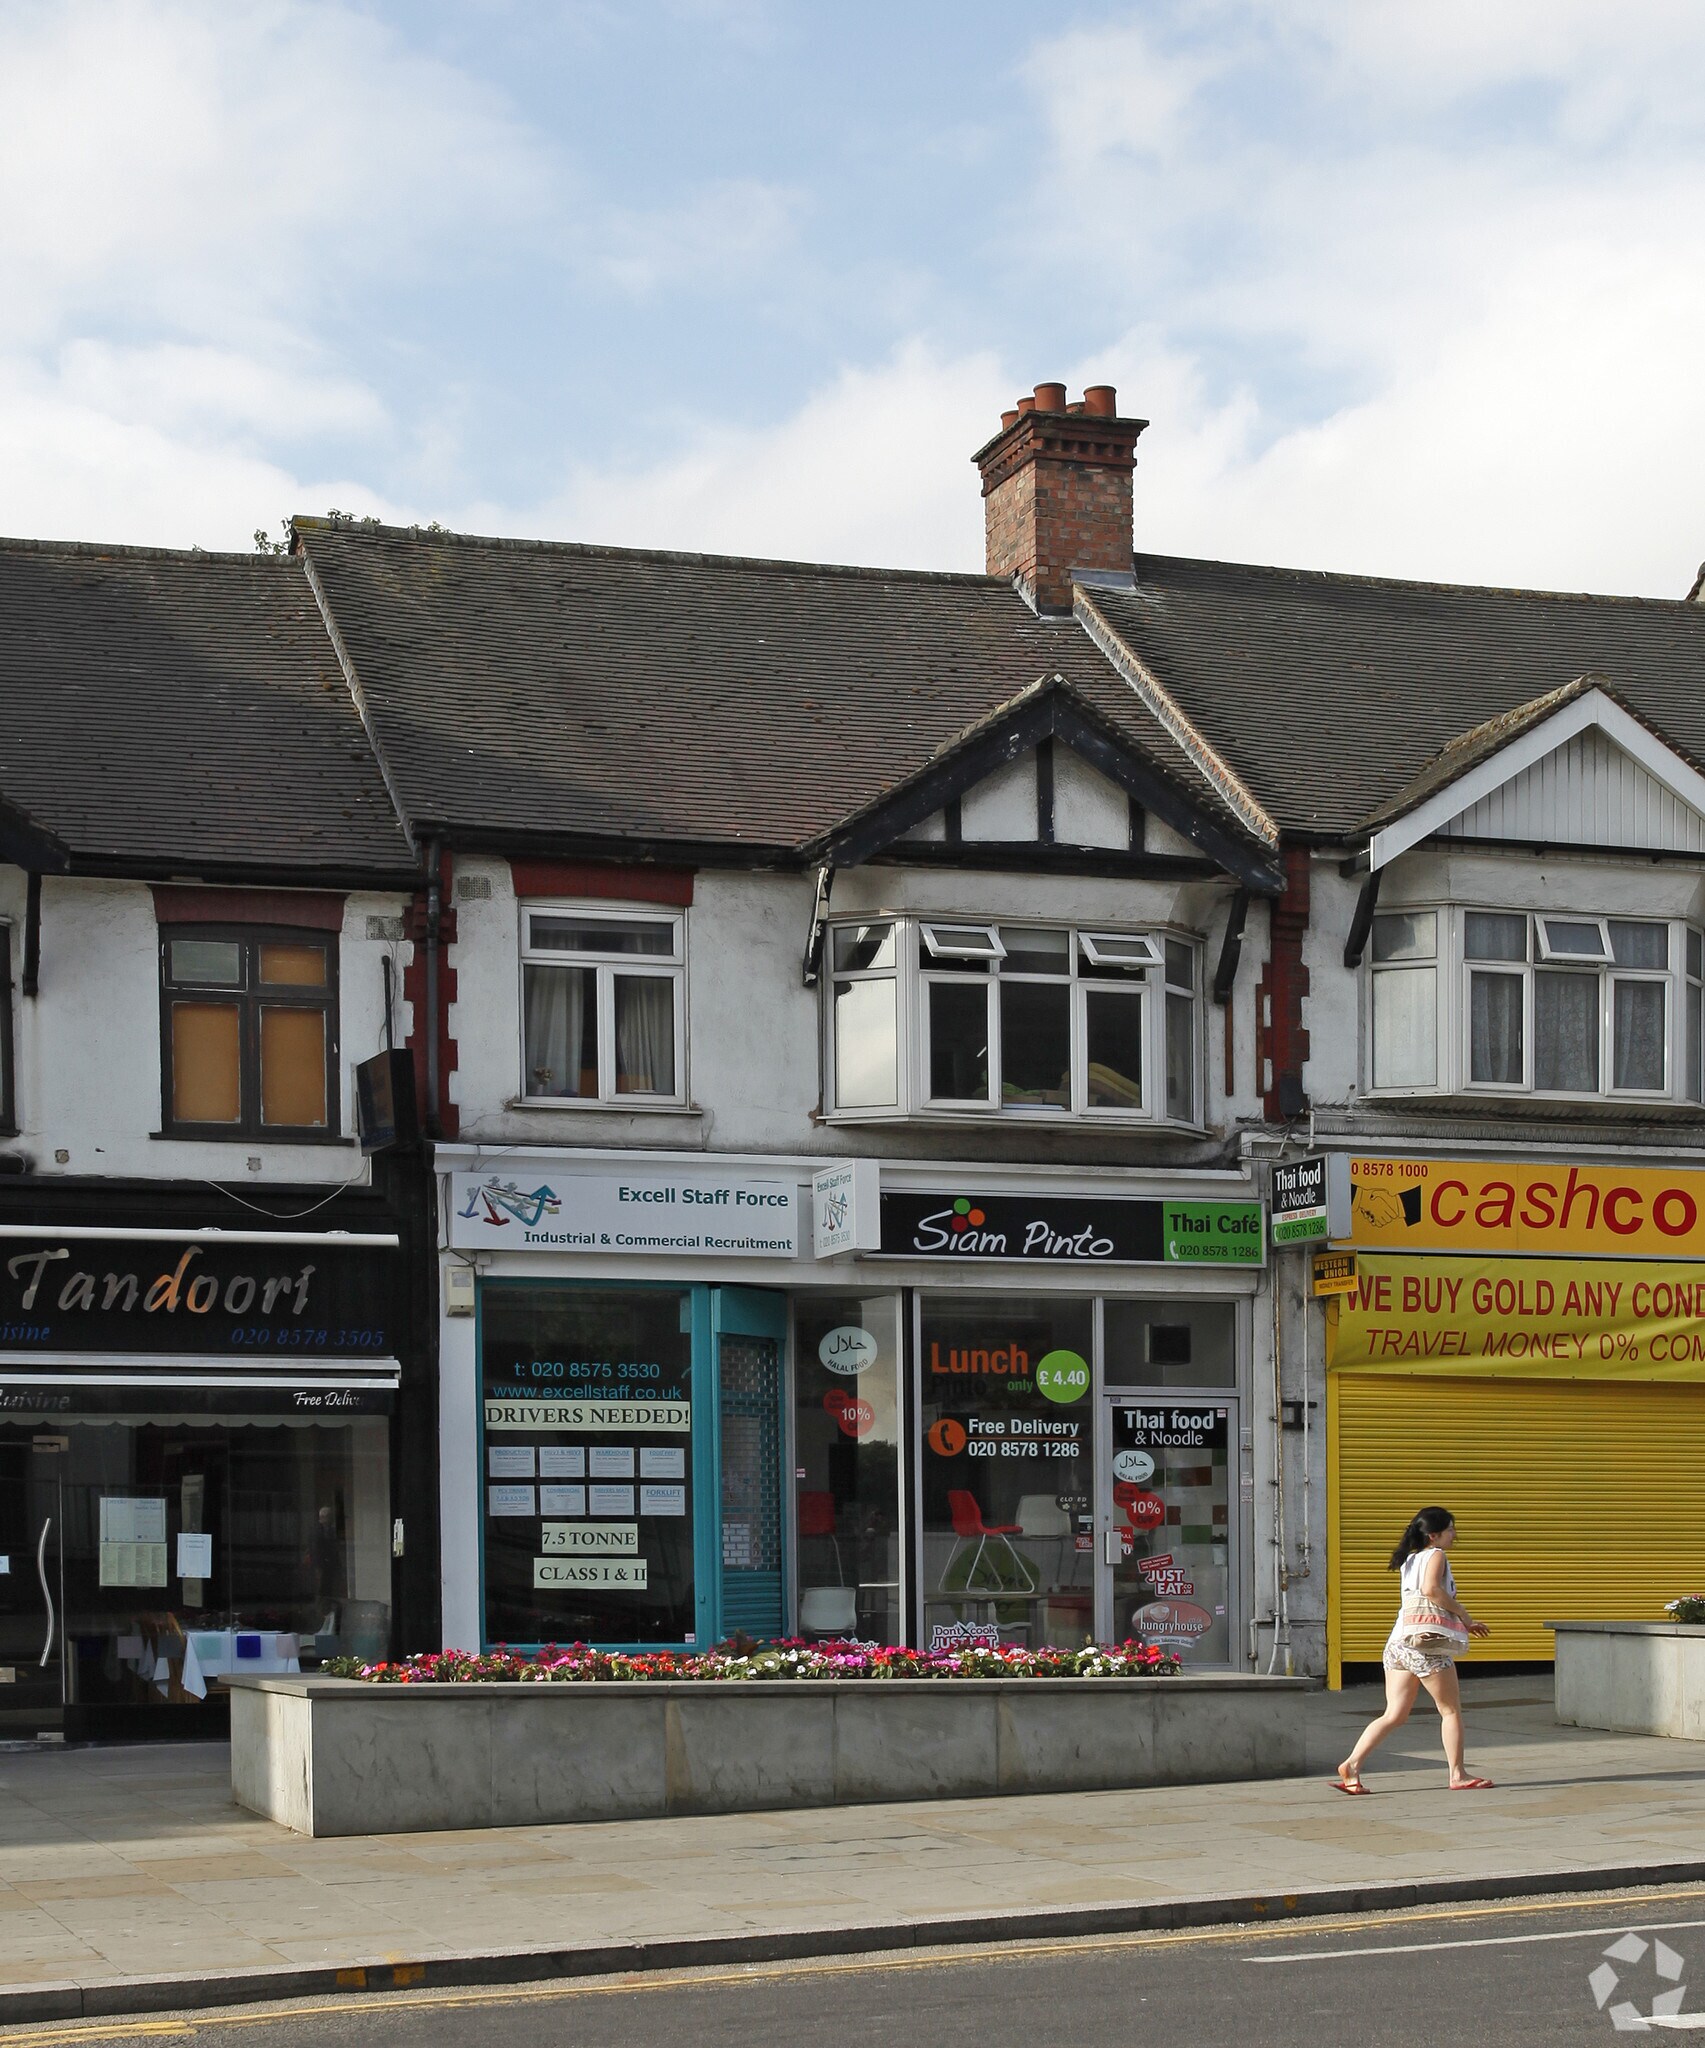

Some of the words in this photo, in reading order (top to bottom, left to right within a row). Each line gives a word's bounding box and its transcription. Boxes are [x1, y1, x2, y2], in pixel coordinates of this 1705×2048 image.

[1275, 1168, 1296, 1191] Thai
[1298, 1161, 1321, 1186] food
[1363, 1163, 1394, 1176] 8578
[1398, 1164, 1428, 1178] 1000
[817, 1179, 830, 1192] Excell
[840, 1173, 851, 1185] Force
[618, 1187, 675, 1203] Excell
[682, 1188, 730, 1205] Staff
[735, 1190, 789, 1206] Force
[1281, 1193, 1288, 1209] &
[1288, 1187, 1316, 1207] Noodle
[1430, 1168, 1697, 1236] cashco
[1169, 1213, 1210, 1233] Thai
[1217, 1213, 1259, 1234] Café
[1279, 1226, 1291, 1240] 020
[1292, 1223, 1307, 1238] 8578
[1308, 1220, 1324, 1235] 1286
[524, 1231, 595, 1244] Industrial
[600, 1233, 611, 1245] &
[615, 1234, 700, 1247] Commercial
[705, 1236, 792, 1250] Recruitment
[913, 1209, 1006, 1253] Siam
[1022, 1220, 1114, 1256] Pinto
[1179, 1245, 1200, 1256] 020
[1202, 1245, 1228, 1257] 8578
[1232, 1246, 1258, 1257] 1286
[1314, 1258, 1348, 1271] WESTERN
[7, 1245, 316, 1315] Tandoori
[1324, 1267, 1348, 1279] UNION
[1347, 1275, 1392, 1312] WE
[1402, 1276, 1464, 1314] BUY
[1472, 1278, 1555, 1315] GOLD
[1561, 1280, 1623, 1317] ANY
[0, 1322, 50, 1341] isine
[231, 1328, 271, 1345] 020
[276, 1328, 328, 1345] 8578
[334, 1329, 385, 1347] 3505
[828, 1334, 867, 1354] حلال
[1366, 1329, 1471, 1356] TRAVEL
[1481, 1331, 1590, 1359] MONEY
[1600, 1333, 1639, 1361] 0%
[827, 1359, 849, 1372] HALAL
[850, 1358, 868, 1371] FOOD
[931, 1342, 1028, 1374] Lunch
[514, 1363, 525, 1377] t:
[531, 1362, 564, 1378] 020
[569, 1363, 612, 1378] 8575
[617, 1363, 660, 1378] 3530
[1039, 1370, 1049, 1385] £
[1053, 1370, 1085, 1385] 4.40
[493, 1384, 682, 1399] www.excellstaff.co.uk
[1007, 1379, 1033, 1393] only
[293, 1391, 322, 1406] Free
[485, 1407, 583, 1423] DRIVERS
[590, 1408, 690, 1425] NEEDED!
[842, 1407, 870, 1420] 10%
[1124, 1410, 1164, 1429] Thai
[1171, 1410, 1214, 1429] food
[968, 1418, 1005, 1434] Free
[1011, 1419, 1079, 1437] Delivery
[1135, 1430, 1146, 1445] &
[1151, 1430, 1204, 1445] Noodle
[968, 1442, 997, 1457] 020
[1001, 1442, 1038, 1457] 8578
[1042, 1442, 1080, 1457] 1286
[1119, 1455, 1148, 1469] حلال
[1131, 1501, 1161, 1515] 10%
[542, 1532, 566, 1545] 7.5
[569, 1531, 636, 1545] TONNE
[539, 1567, 598, 1581] CLASS
[603, 1567, 610, 1581] I
[615, 1567, 628, 1581] &
[634, 1567, 647, 1581] II
[1148, 1569, 1184, 1582] JUST
[1157, 1582, 1184, 1595] EAT
[1140, 1609, 1203, 1634] hungryhouse
[970, 1625, 996, 1635] cook
[970, 1636, 997, 1648] ET
